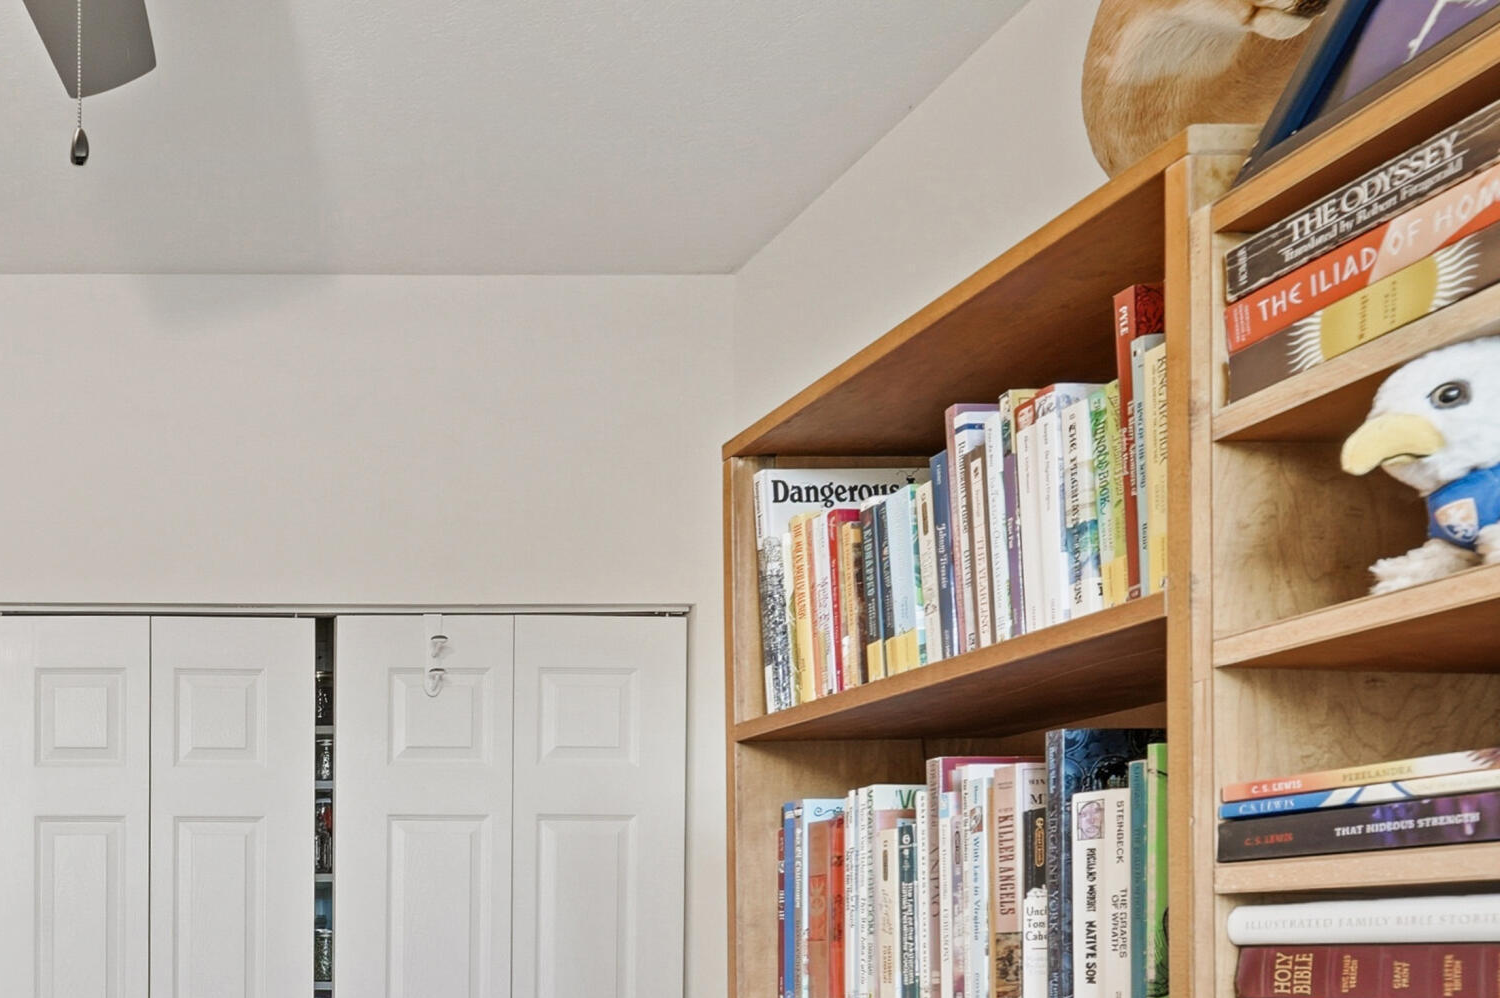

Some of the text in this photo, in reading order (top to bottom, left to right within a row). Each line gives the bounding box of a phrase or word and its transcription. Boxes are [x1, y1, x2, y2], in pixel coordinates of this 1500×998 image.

[1287, 131, 1460, 243] THE ODYSSEY
[1356, 196, 1398, 225] Robert
[1257, 218, 1423, 321] THE ILIAD OF
[772, 479, 900, 509] Dangerous
[1116, 800, 1125, 864] STEINBECK
[1334, 825, 1365, 838] THAT
[1365, 820, 1416, 834] HIDEOUS
[998, 814, 1016, 916] KILLER ANGELS
[1048, 888, 1060, 932] YORK
[1111, 894, 1119, 952] OF WRATH
[1120, 888, 1128, 959] THE GRAPES
[1244, 914, 1433, 931] ILLUSTRATED FAMILY BIBLE
[1085, 920, 1097, 959] NATIVE
[1085, 962, 1097, 985] SON
[1273, 952, 1293, 994] HOLY
[1292, 953, 1314, 996] BIBLE
[1392, 961, 1401, 989] GIANT
